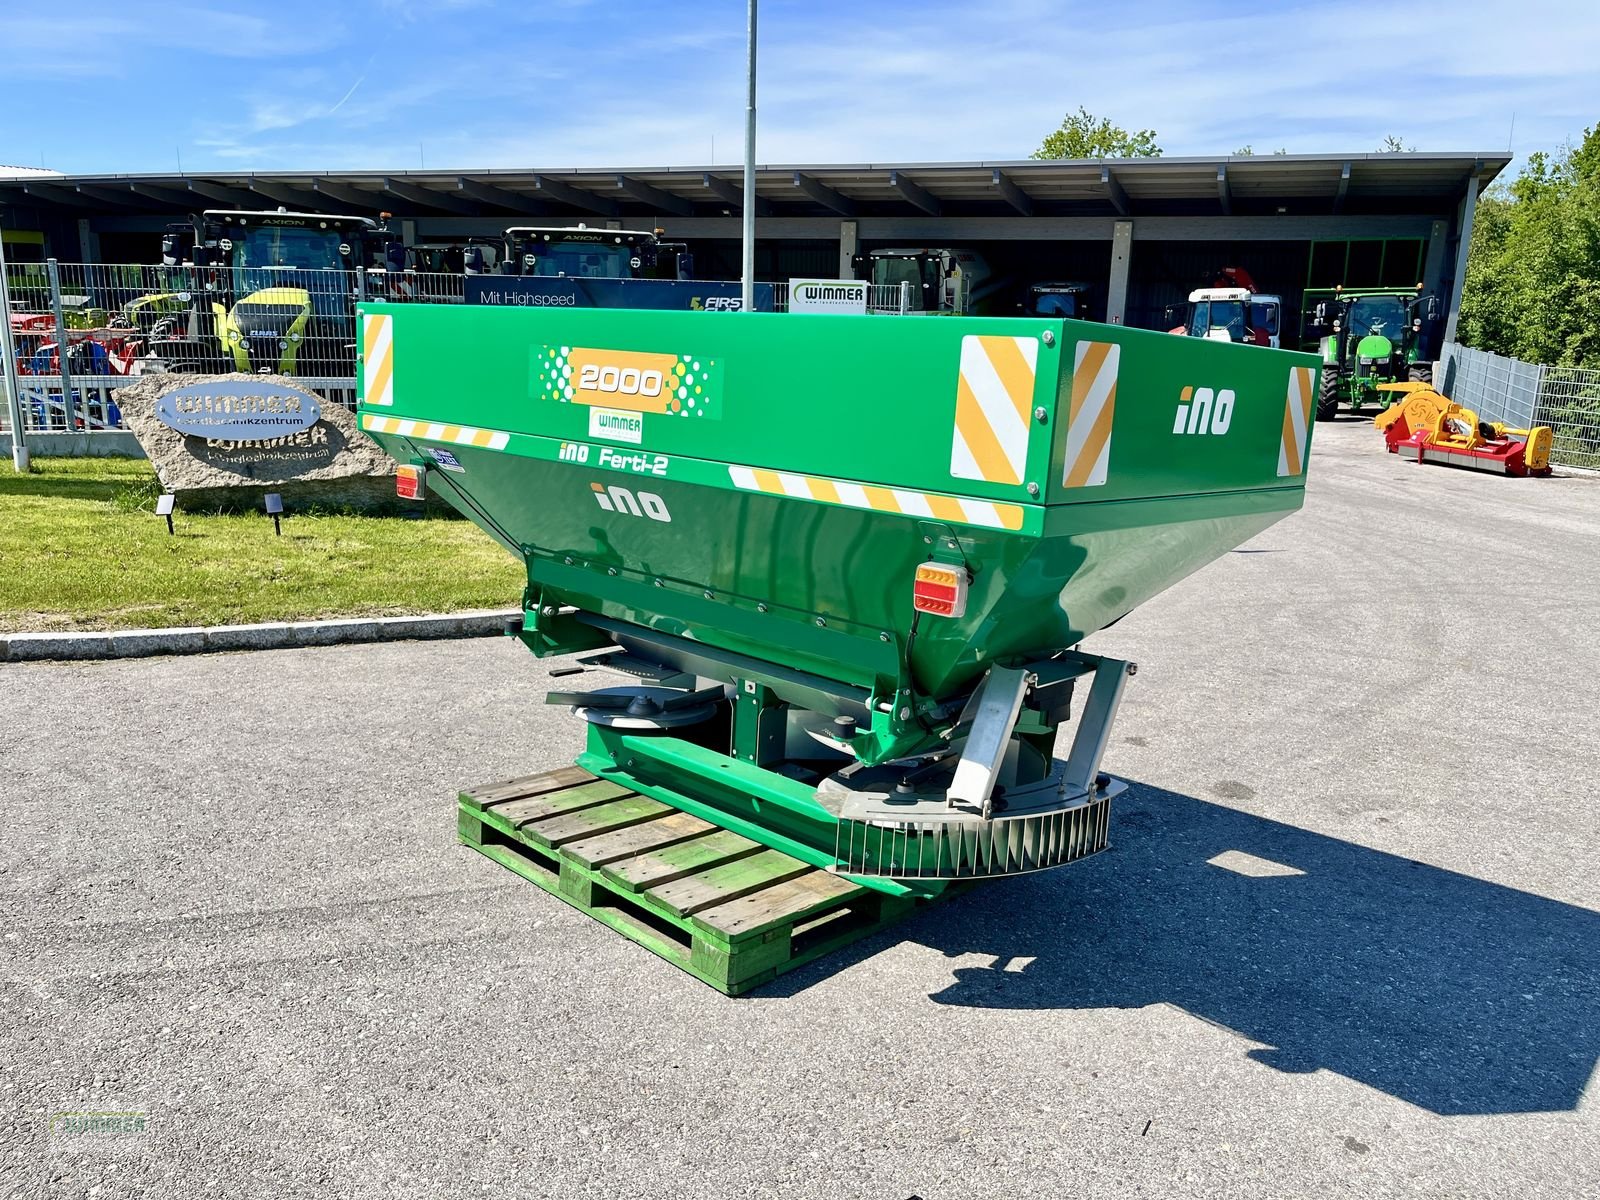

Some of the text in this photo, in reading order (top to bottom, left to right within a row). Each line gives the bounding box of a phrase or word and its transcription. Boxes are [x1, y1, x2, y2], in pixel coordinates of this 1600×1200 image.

[480, 291, 575, 307] Mit Highspeed
[805, 287, 863, 301] WIMMER
[579, 364, 663, 397] 2000
[175, 395, 303, 414] WIMMER
[599, 414, 641, 432] WIMMER
[599, 448, 669, 475] Ferti-2
